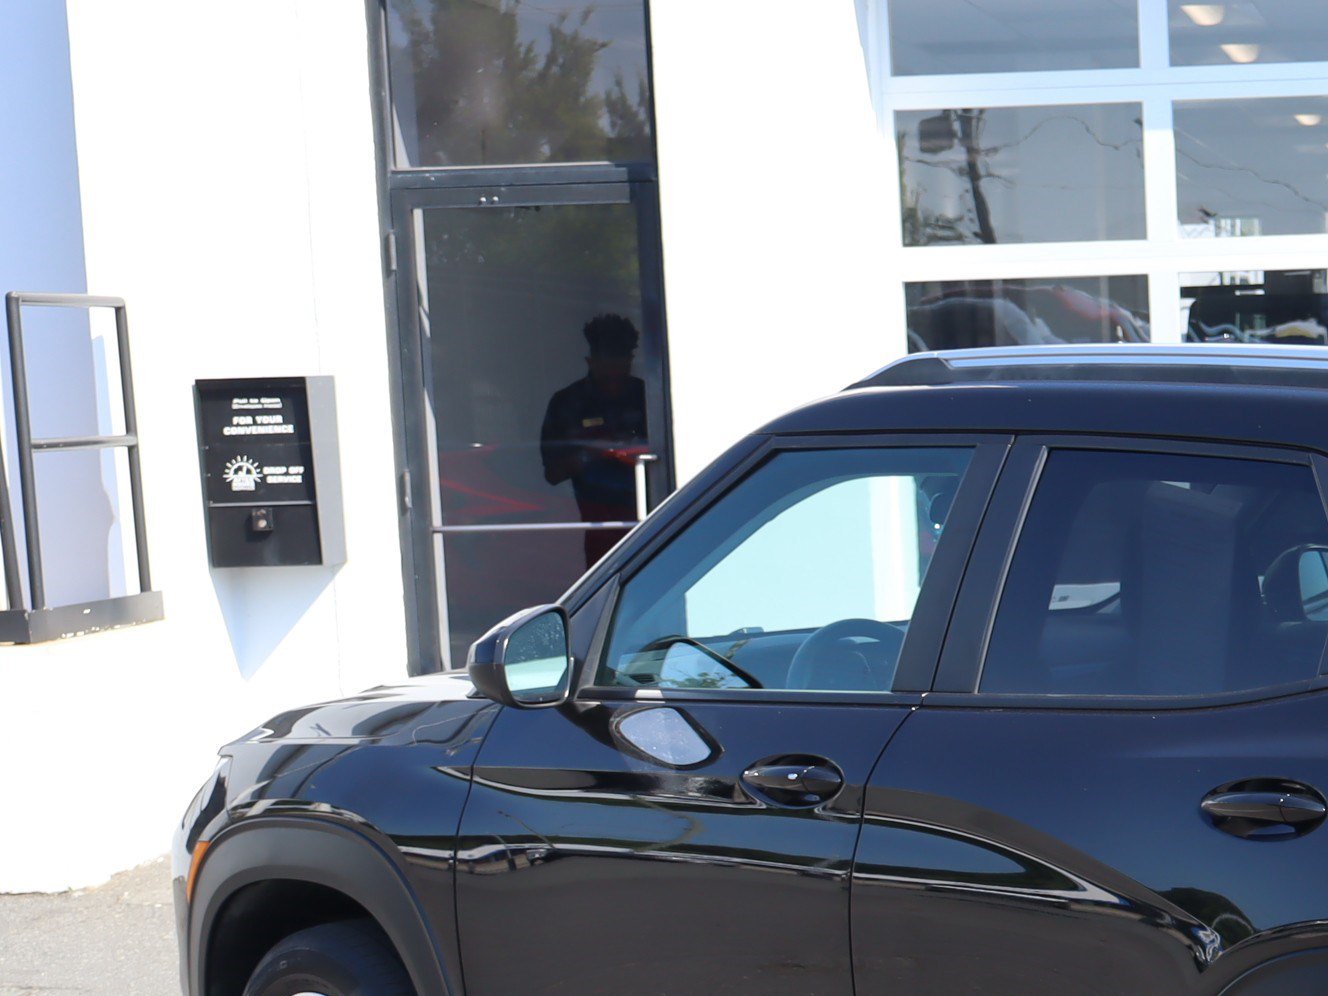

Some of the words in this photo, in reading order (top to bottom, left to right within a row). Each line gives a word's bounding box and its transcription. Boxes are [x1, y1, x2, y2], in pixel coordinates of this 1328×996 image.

[232, 415, 253, 425] FOR
[255, 415, 283, 424] YOUR
[223, 424, 294, 435] CONVENIENCE
[262, 466, 287, 475] DROP
[288, 466, 304, 474] OFF
[266, 475, 303, 484] SERVICE
